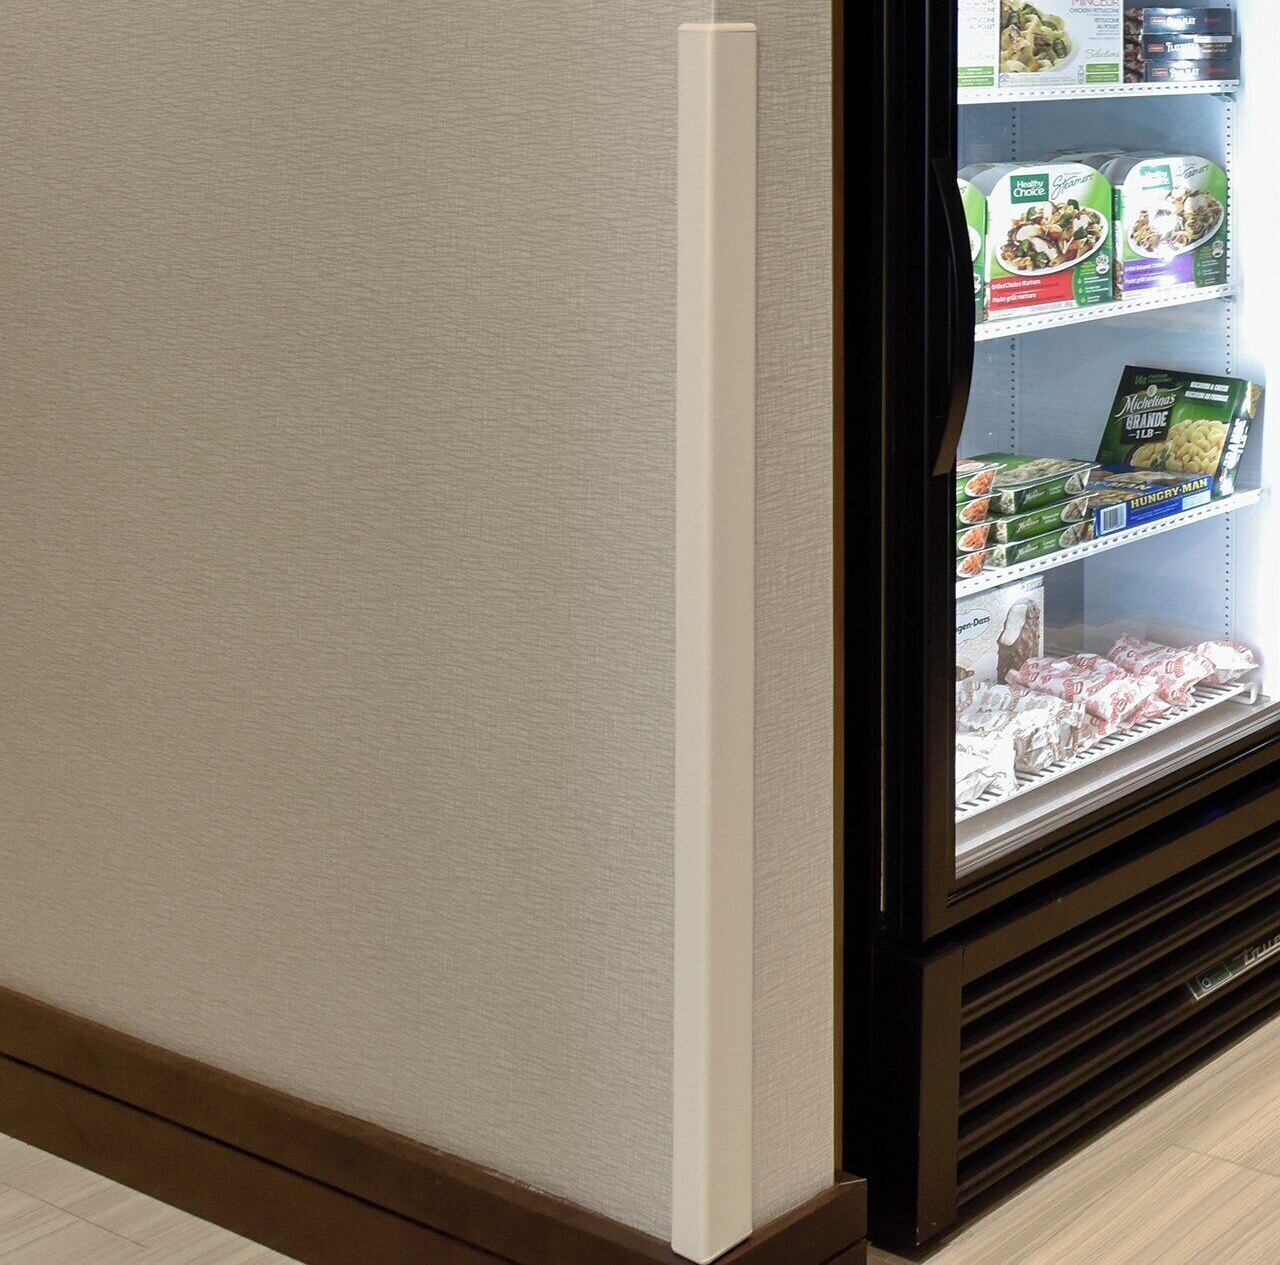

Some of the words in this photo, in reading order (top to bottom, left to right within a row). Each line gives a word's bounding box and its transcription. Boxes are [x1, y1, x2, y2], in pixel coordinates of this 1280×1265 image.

[1013, 187, 1047, 197] Choice
[1017, 180, 1043, 189] Healthy
[1051, 174, 1094, 200] Steamers
[1115, 393, 1177, 417] Michelina's
[1126, 411, 1168, 430] GRANDE
[1130, 478, 1208, 509] HUNGRY-MAN
